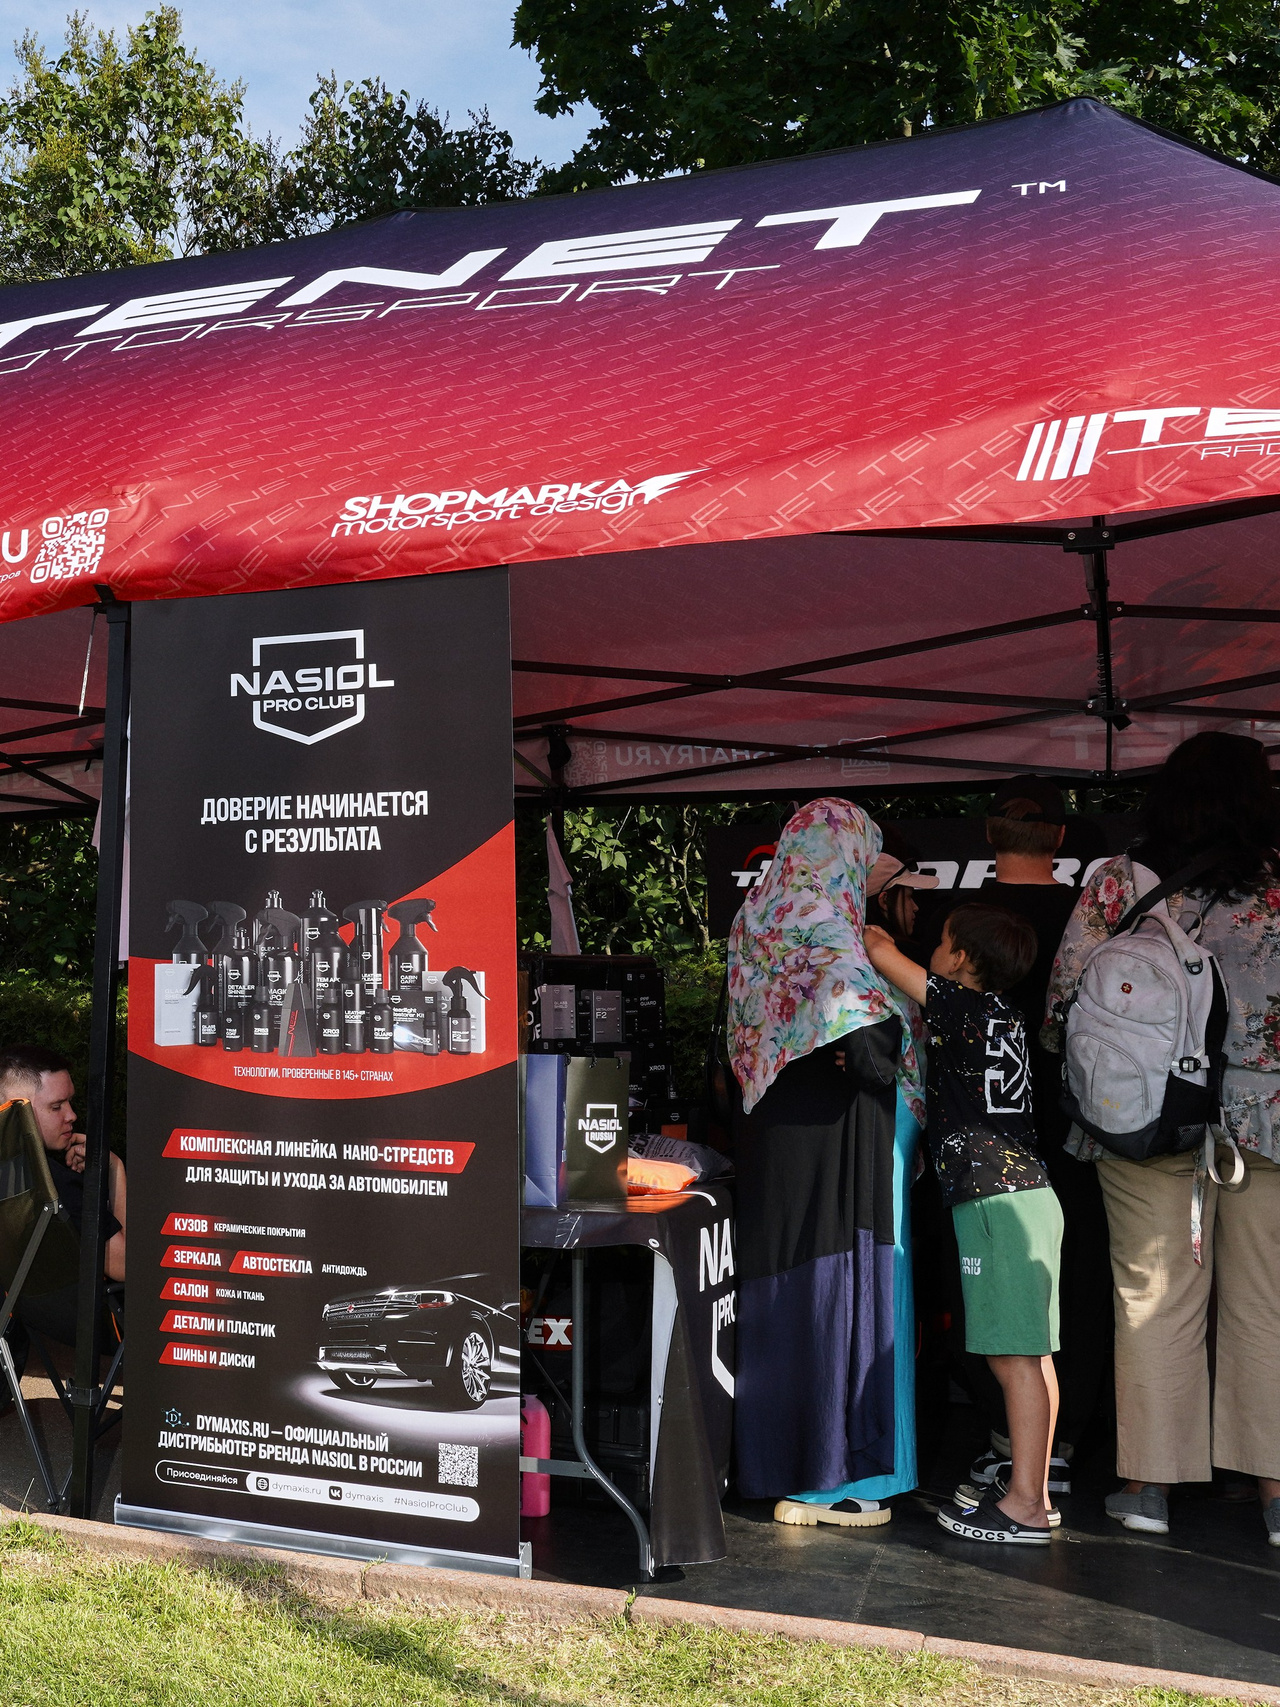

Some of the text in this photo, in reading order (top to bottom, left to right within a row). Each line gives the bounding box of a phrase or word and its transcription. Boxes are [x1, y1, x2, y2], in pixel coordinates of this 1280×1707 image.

[339, 479, 635, 521] SHOPMARKA
[331, 489, 650, 538] motorsport design
[231, 664, 395, 697] NASIOL
[263, 693, 356, 713] PRO CLUB
[200, 790, 429, 825] ДОВЕРИЕ НАЧИНАЕТСЯ
[245, 826, 382, 854] С РЕЗУЛЬТАТА
[233, 1066, 280, 1079] ТЕХНОЛОГИИ,
[281, 1067, 334, 1081] ПРОВЕРЕННЫЕ
[342, 1069, 359, 1081] 145+
[360, 1070, 394, 1082] СТРАНАХ
[578, 1118, 623, 1131] NASIOL
[590, 1131, 613, 1142] RUSSIA
[180, 1135, 454, 1166] КОМПЛЕКСНАЯ ЛИНЕЙКА НАНО-СТРЕДСТВ
[185, 1166, 448, 1197] ДЛЯ ЗАЩИТЫ И УХОДА ЗА АВТОМОБИЛЕМ
[174, 1218, 306, 1238] КУЗОВ КЕРАМИЧЕСКИЕ ПОКРЫТИЯ
[174, 1250, 221, 1267] ЗЕРКАЛА
[243, 1255, 368, 1277] АВТОСТЕКЛА АНТИДОЖДЬ
[173, 1282, 209, 1298] САЛОН
[216, 1288, 236, 1299] КОЖА
[242, 1290, 265, 1302] ТКАНЬ
[173, 1315, 276, 1338] ДЕТАЛИ И ПЛАСТИК
[173, 1347, 256, 1369] ШИНЫ И ДИСКИ
[196, 1414, 269, 1439] DYMAXIS.RU
[284, 1424, 389, 1453] ОФИЦИАЛЬНЫЙ
[158, 1430, 423, 1478] ДИСТРИБЬЮТЕР БРЕНДА NASIOL В РОССИИ
[166, 1467, 238, 1486] Присоединяйся
[272, 1479, 322, 1496] dymaxis.ru
[344, 1490, 384, 1504] dymaxis
[394, 1495, 469, 1514] #NasiolProClub
[952, 1523, 1006, 1542] crocs
